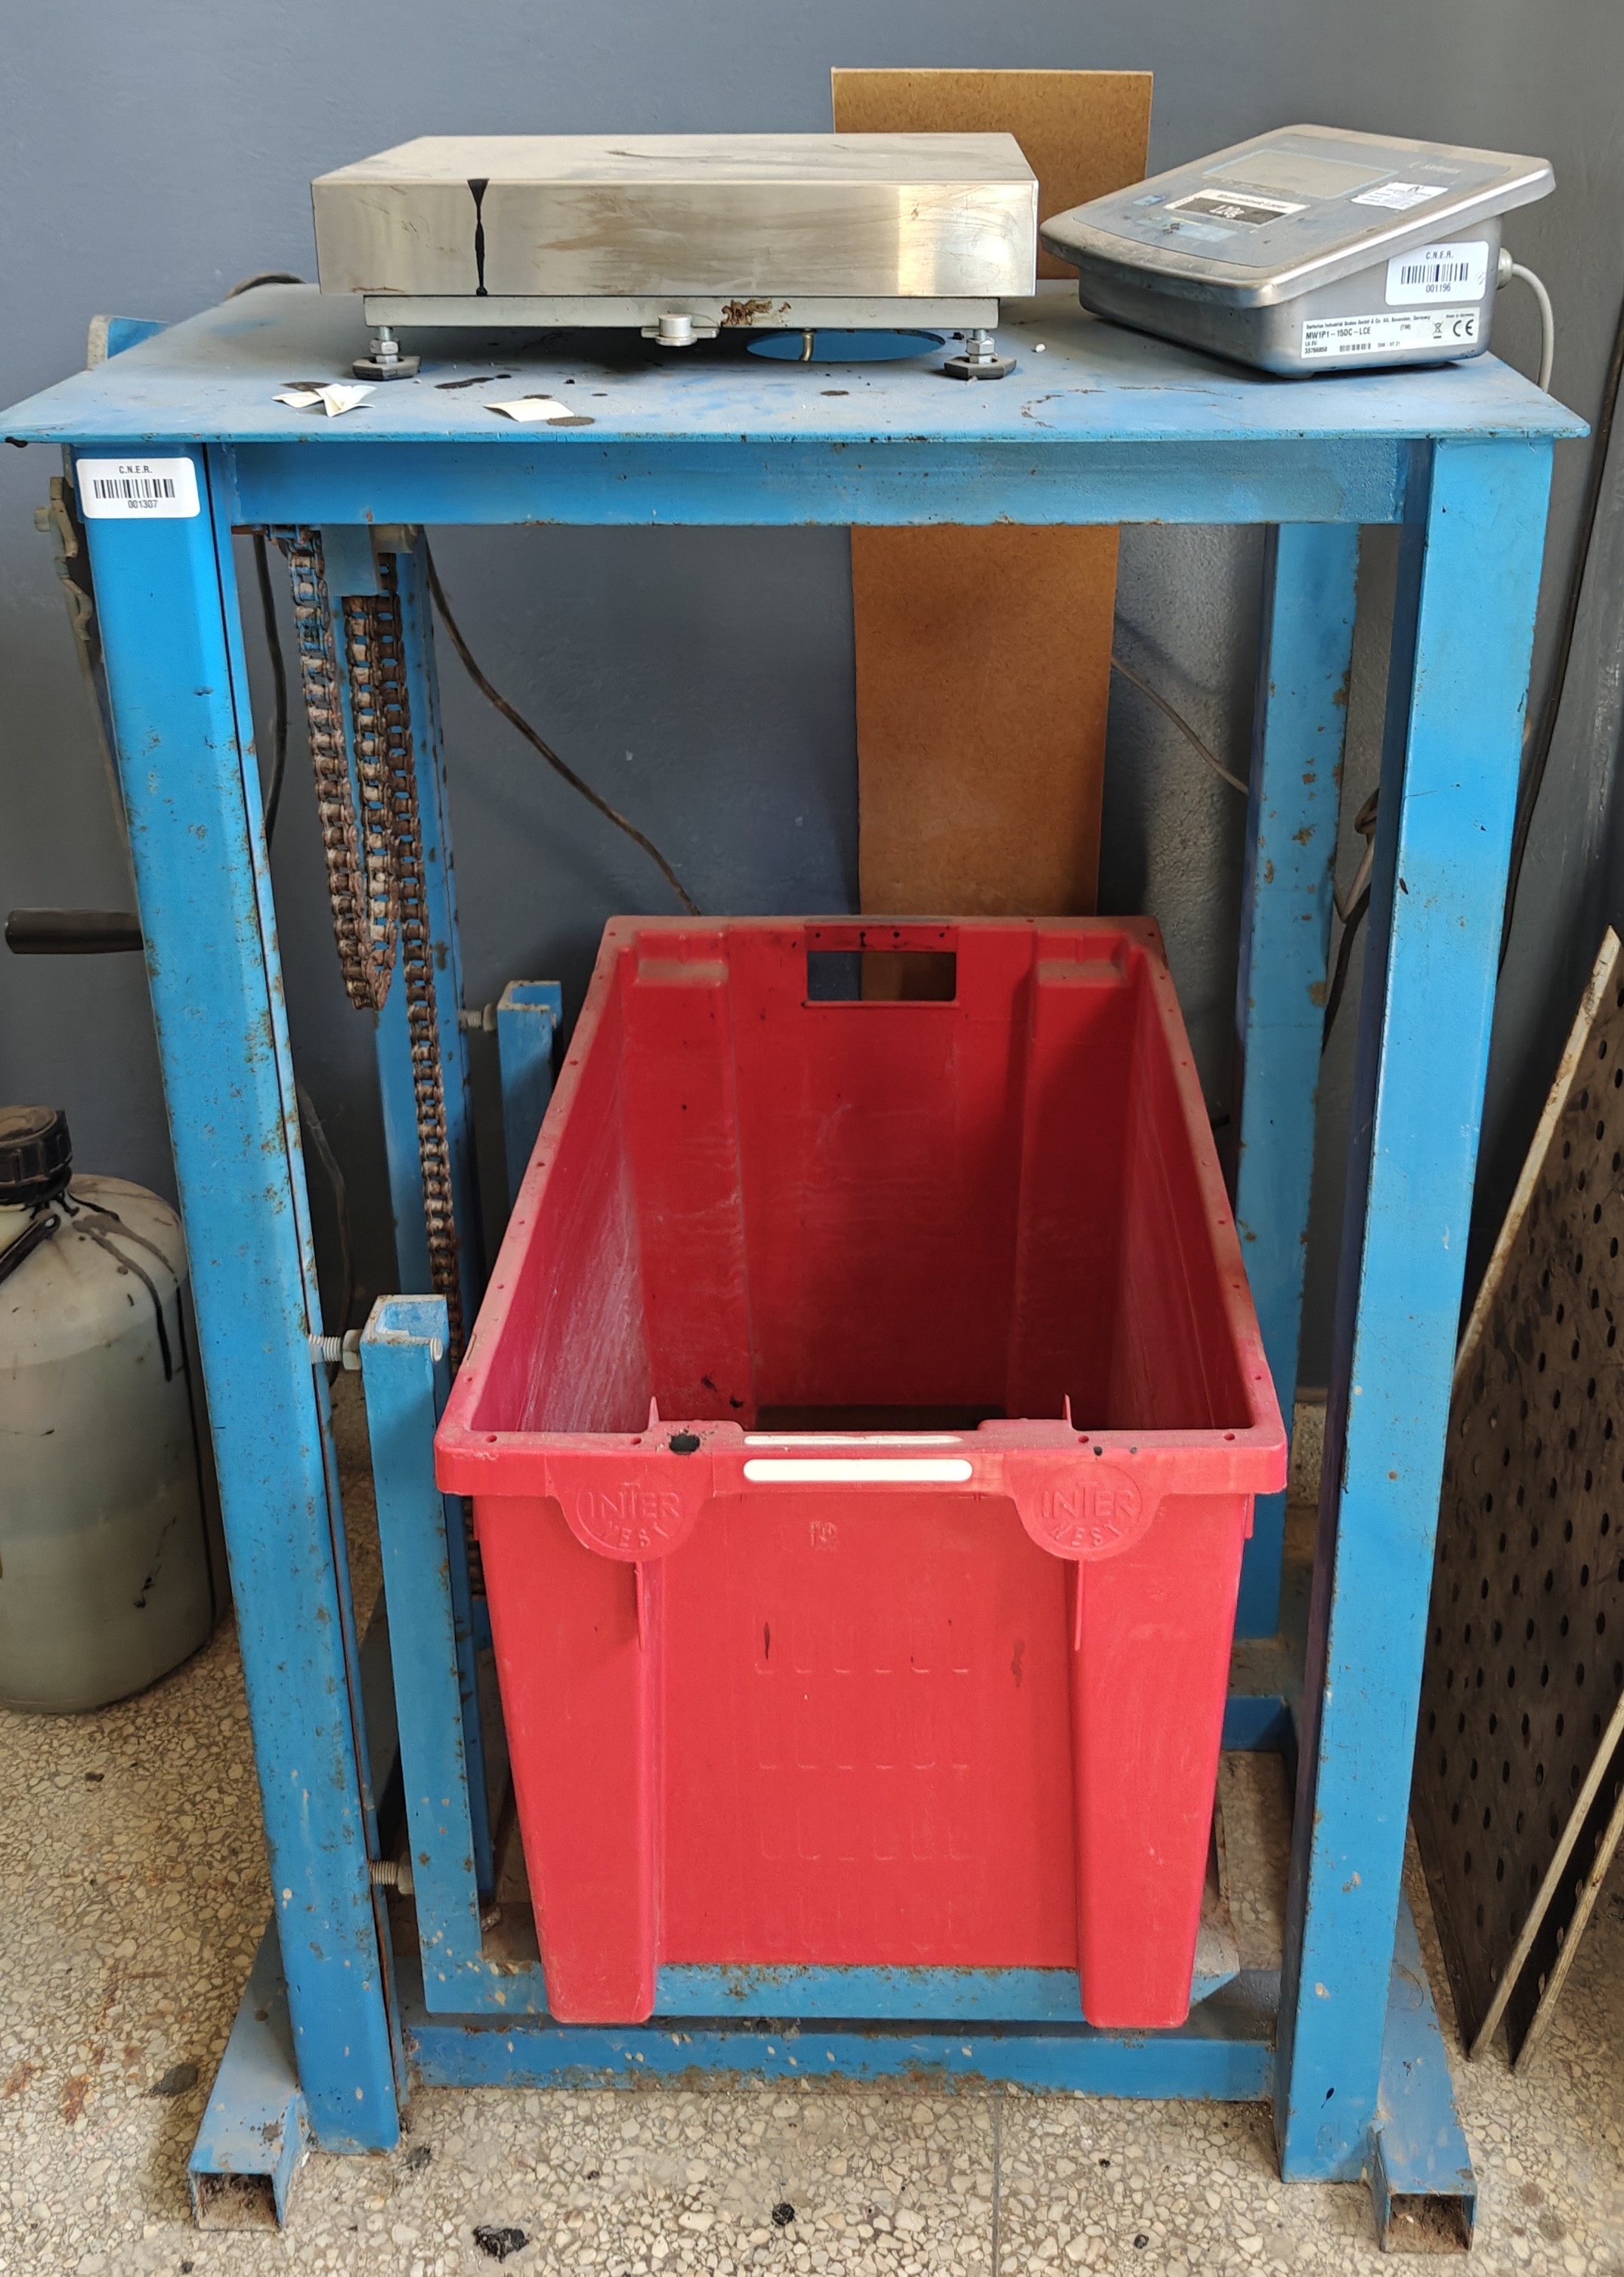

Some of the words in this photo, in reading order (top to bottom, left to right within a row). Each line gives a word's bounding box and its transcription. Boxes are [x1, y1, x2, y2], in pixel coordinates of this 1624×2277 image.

[1425, 250, 1454, 260] C.N.E.R.
[1425, 283, 1451, 293] 001196
[119, 466, 153, 475] C.N.E.R.
[128, 500, 159, 509] 001307
[1042, 1481, 1135, 1519] INTER
